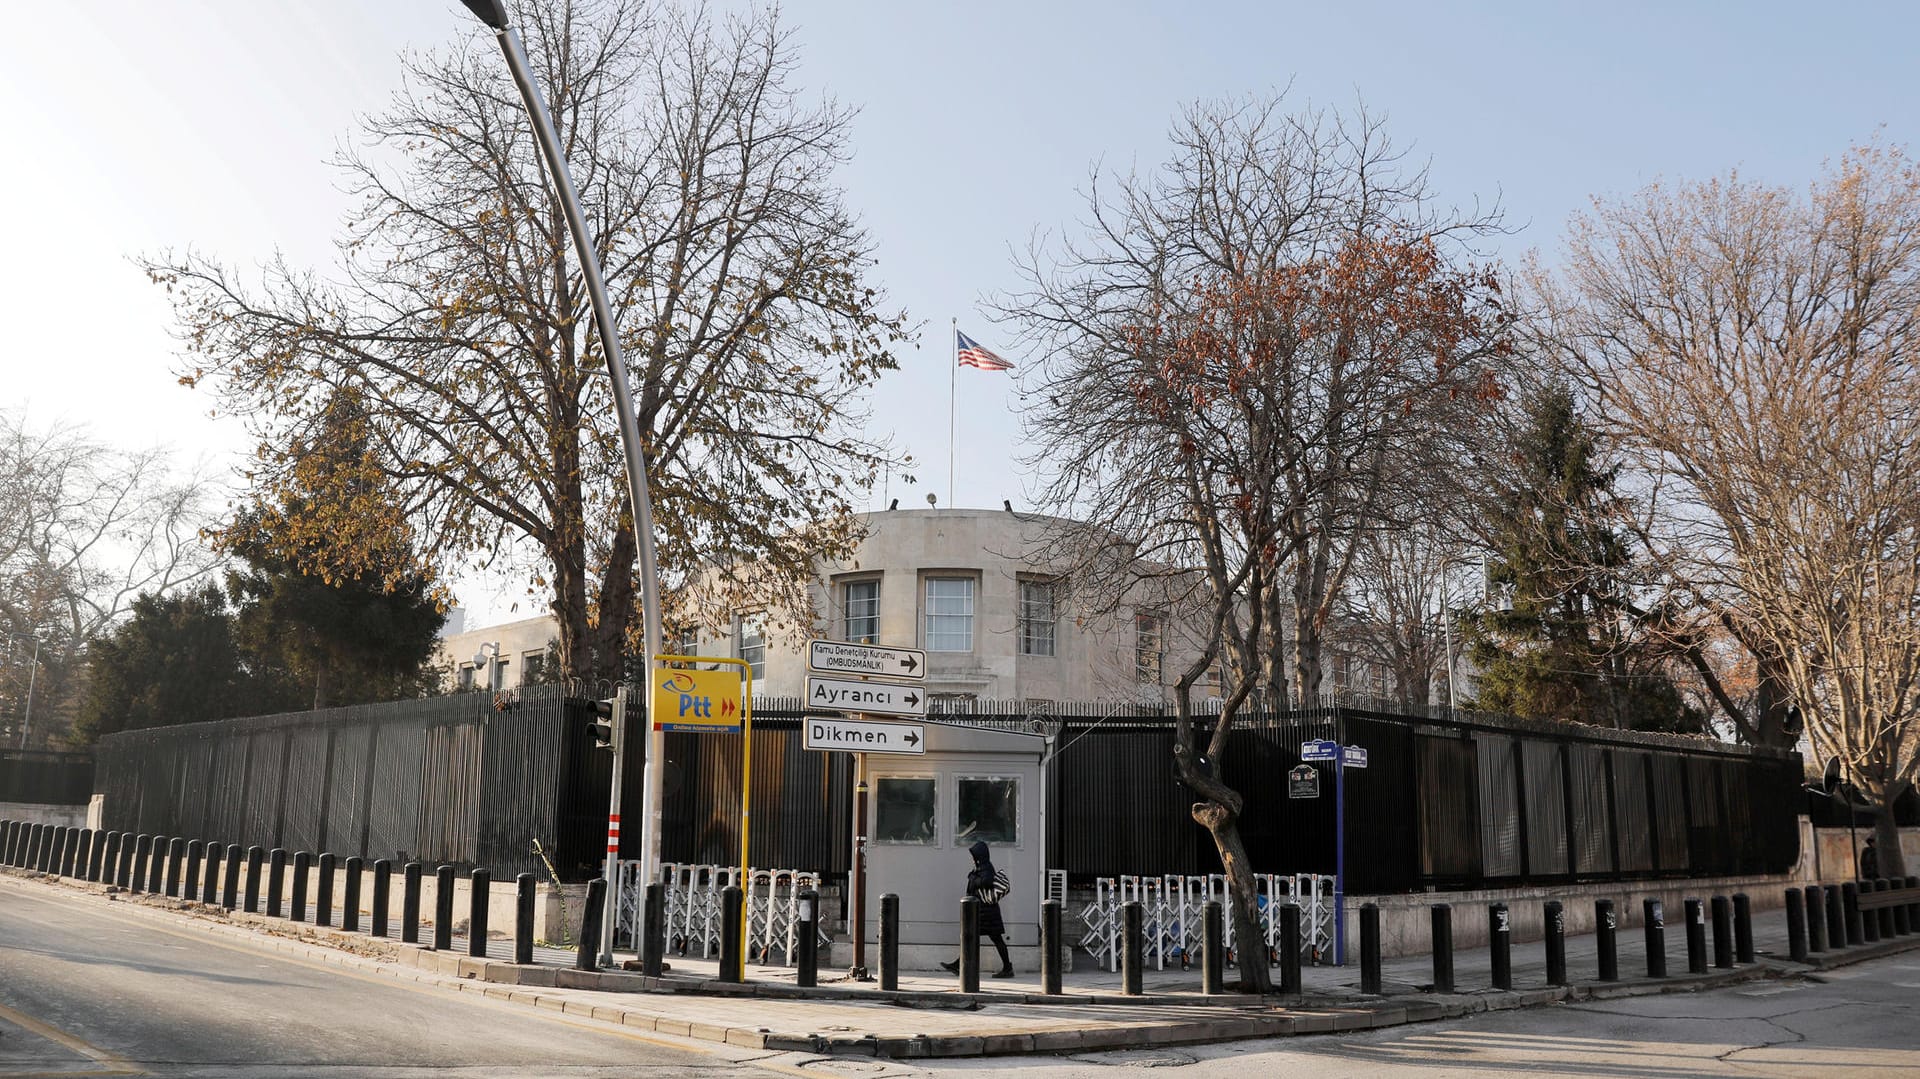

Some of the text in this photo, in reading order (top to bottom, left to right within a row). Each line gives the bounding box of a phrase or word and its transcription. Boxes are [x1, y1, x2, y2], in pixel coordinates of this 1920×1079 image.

[815, 643, 834, 655] Kamu
[870, 650, 896, 660] Kurumu
[814, 684, 892, 705] Ayrancı
[679, 693, 712, 718] Ptt
[813, 725, 888, 744] Dikmen
